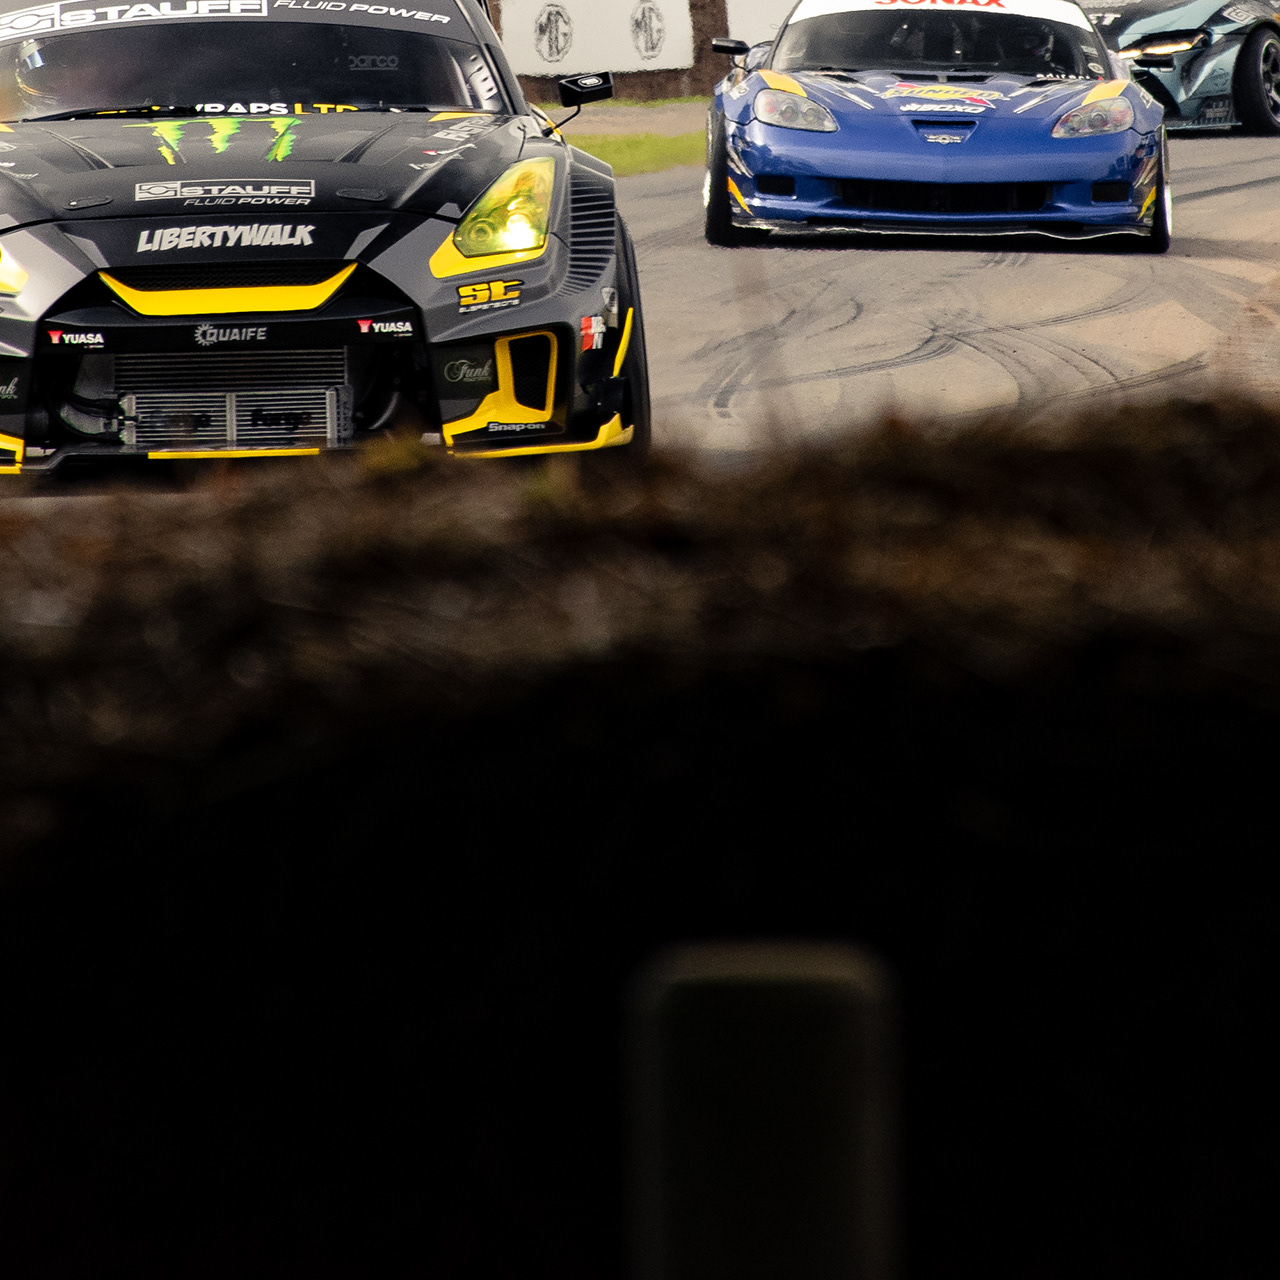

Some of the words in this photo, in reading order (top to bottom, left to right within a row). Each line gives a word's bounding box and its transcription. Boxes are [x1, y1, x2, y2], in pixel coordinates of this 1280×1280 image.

[60, 0, 262, 27] STAUFF
[273, 0, 348, 11] FLUID
[349, 3, 451, 24] POWER
[181, 185, 311, 196] STAUFF
[183, 197, 236, 206] FLUID
[237, 197, 312, 206] POWER
[137, 223, 316, 253] LIBERTYWALK
[198, 324, 267, 343] QUAIFE
[372, 321, 413, 333] YUASA
[61, 333, 104, 344] YUASA
[443, 359, 492, 382] Funk
[488, 422, 546, 432] Snap-on
